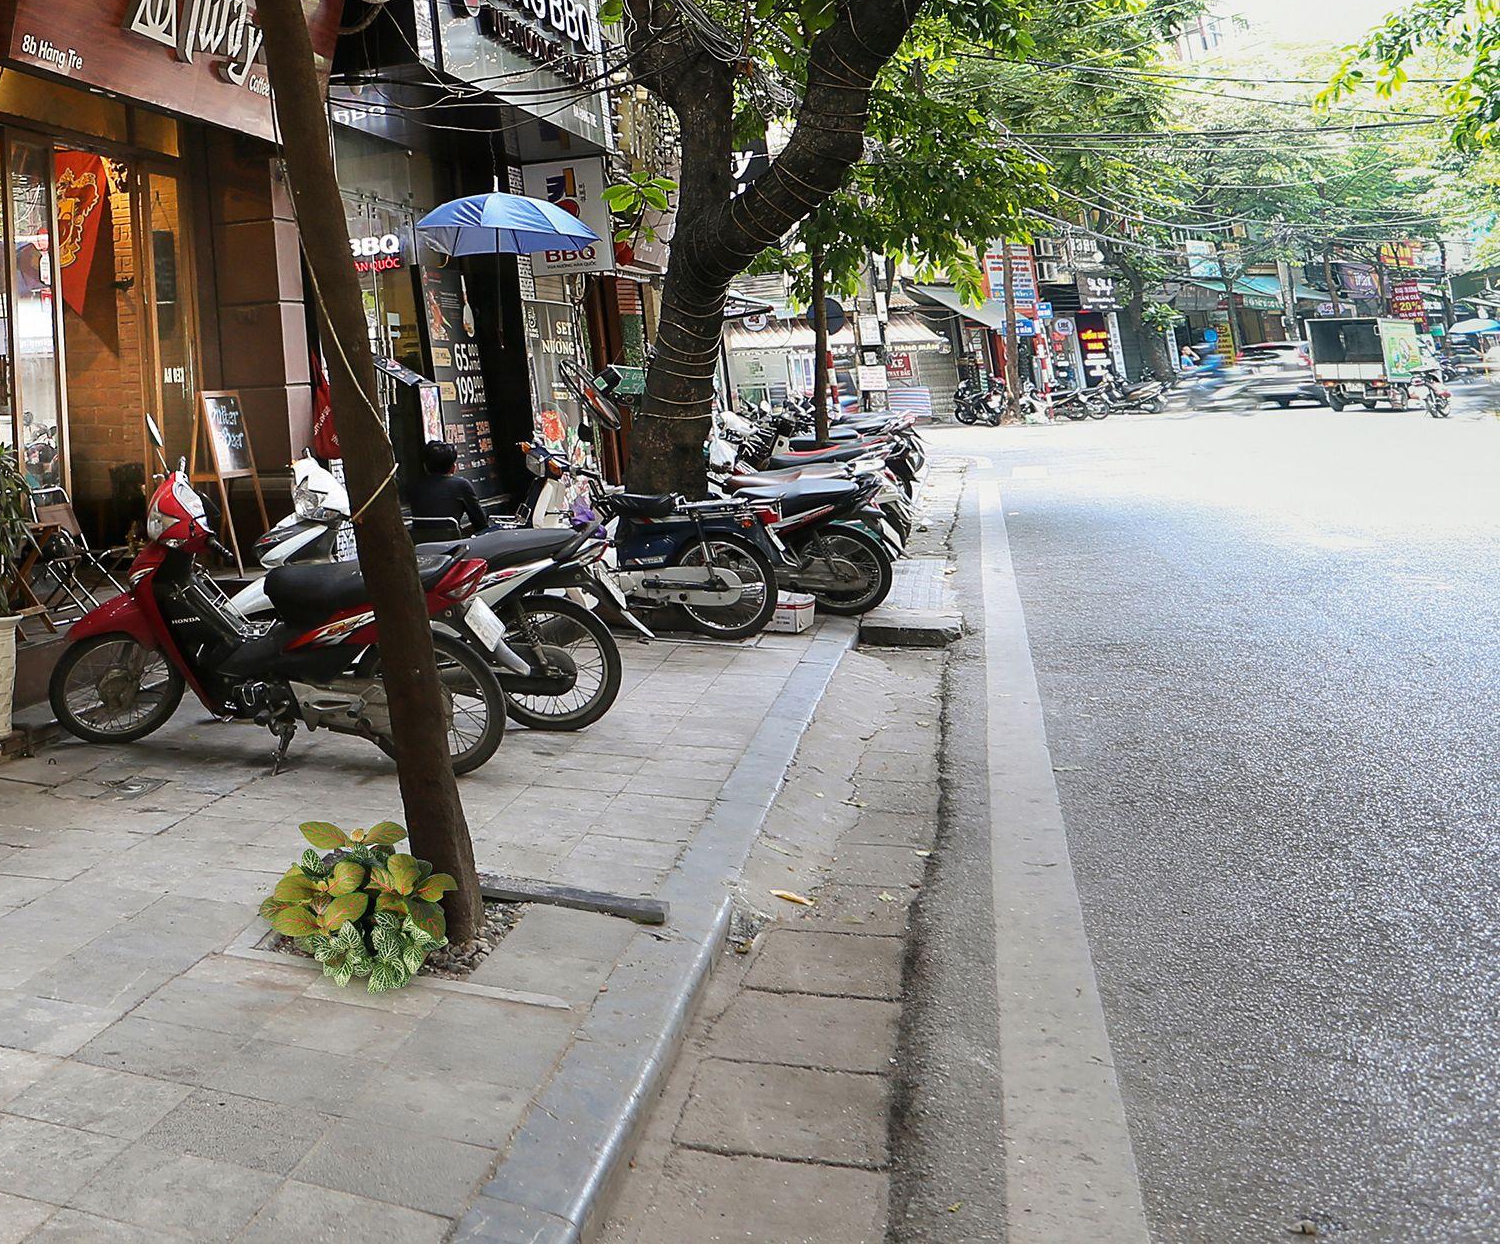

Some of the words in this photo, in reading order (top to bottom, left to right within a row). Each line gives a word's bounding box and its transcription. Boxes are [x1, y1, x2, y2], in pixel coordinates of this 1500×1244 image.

[22, 34, 37, 55] 8b
[38, 39, 66, 69] Hàng
[67, 49, 83, 70] Tre
[555, 320, 573, 336] SET
[891, 358, 905, 369] XE
[171, 616, 201, 625] HONDA
